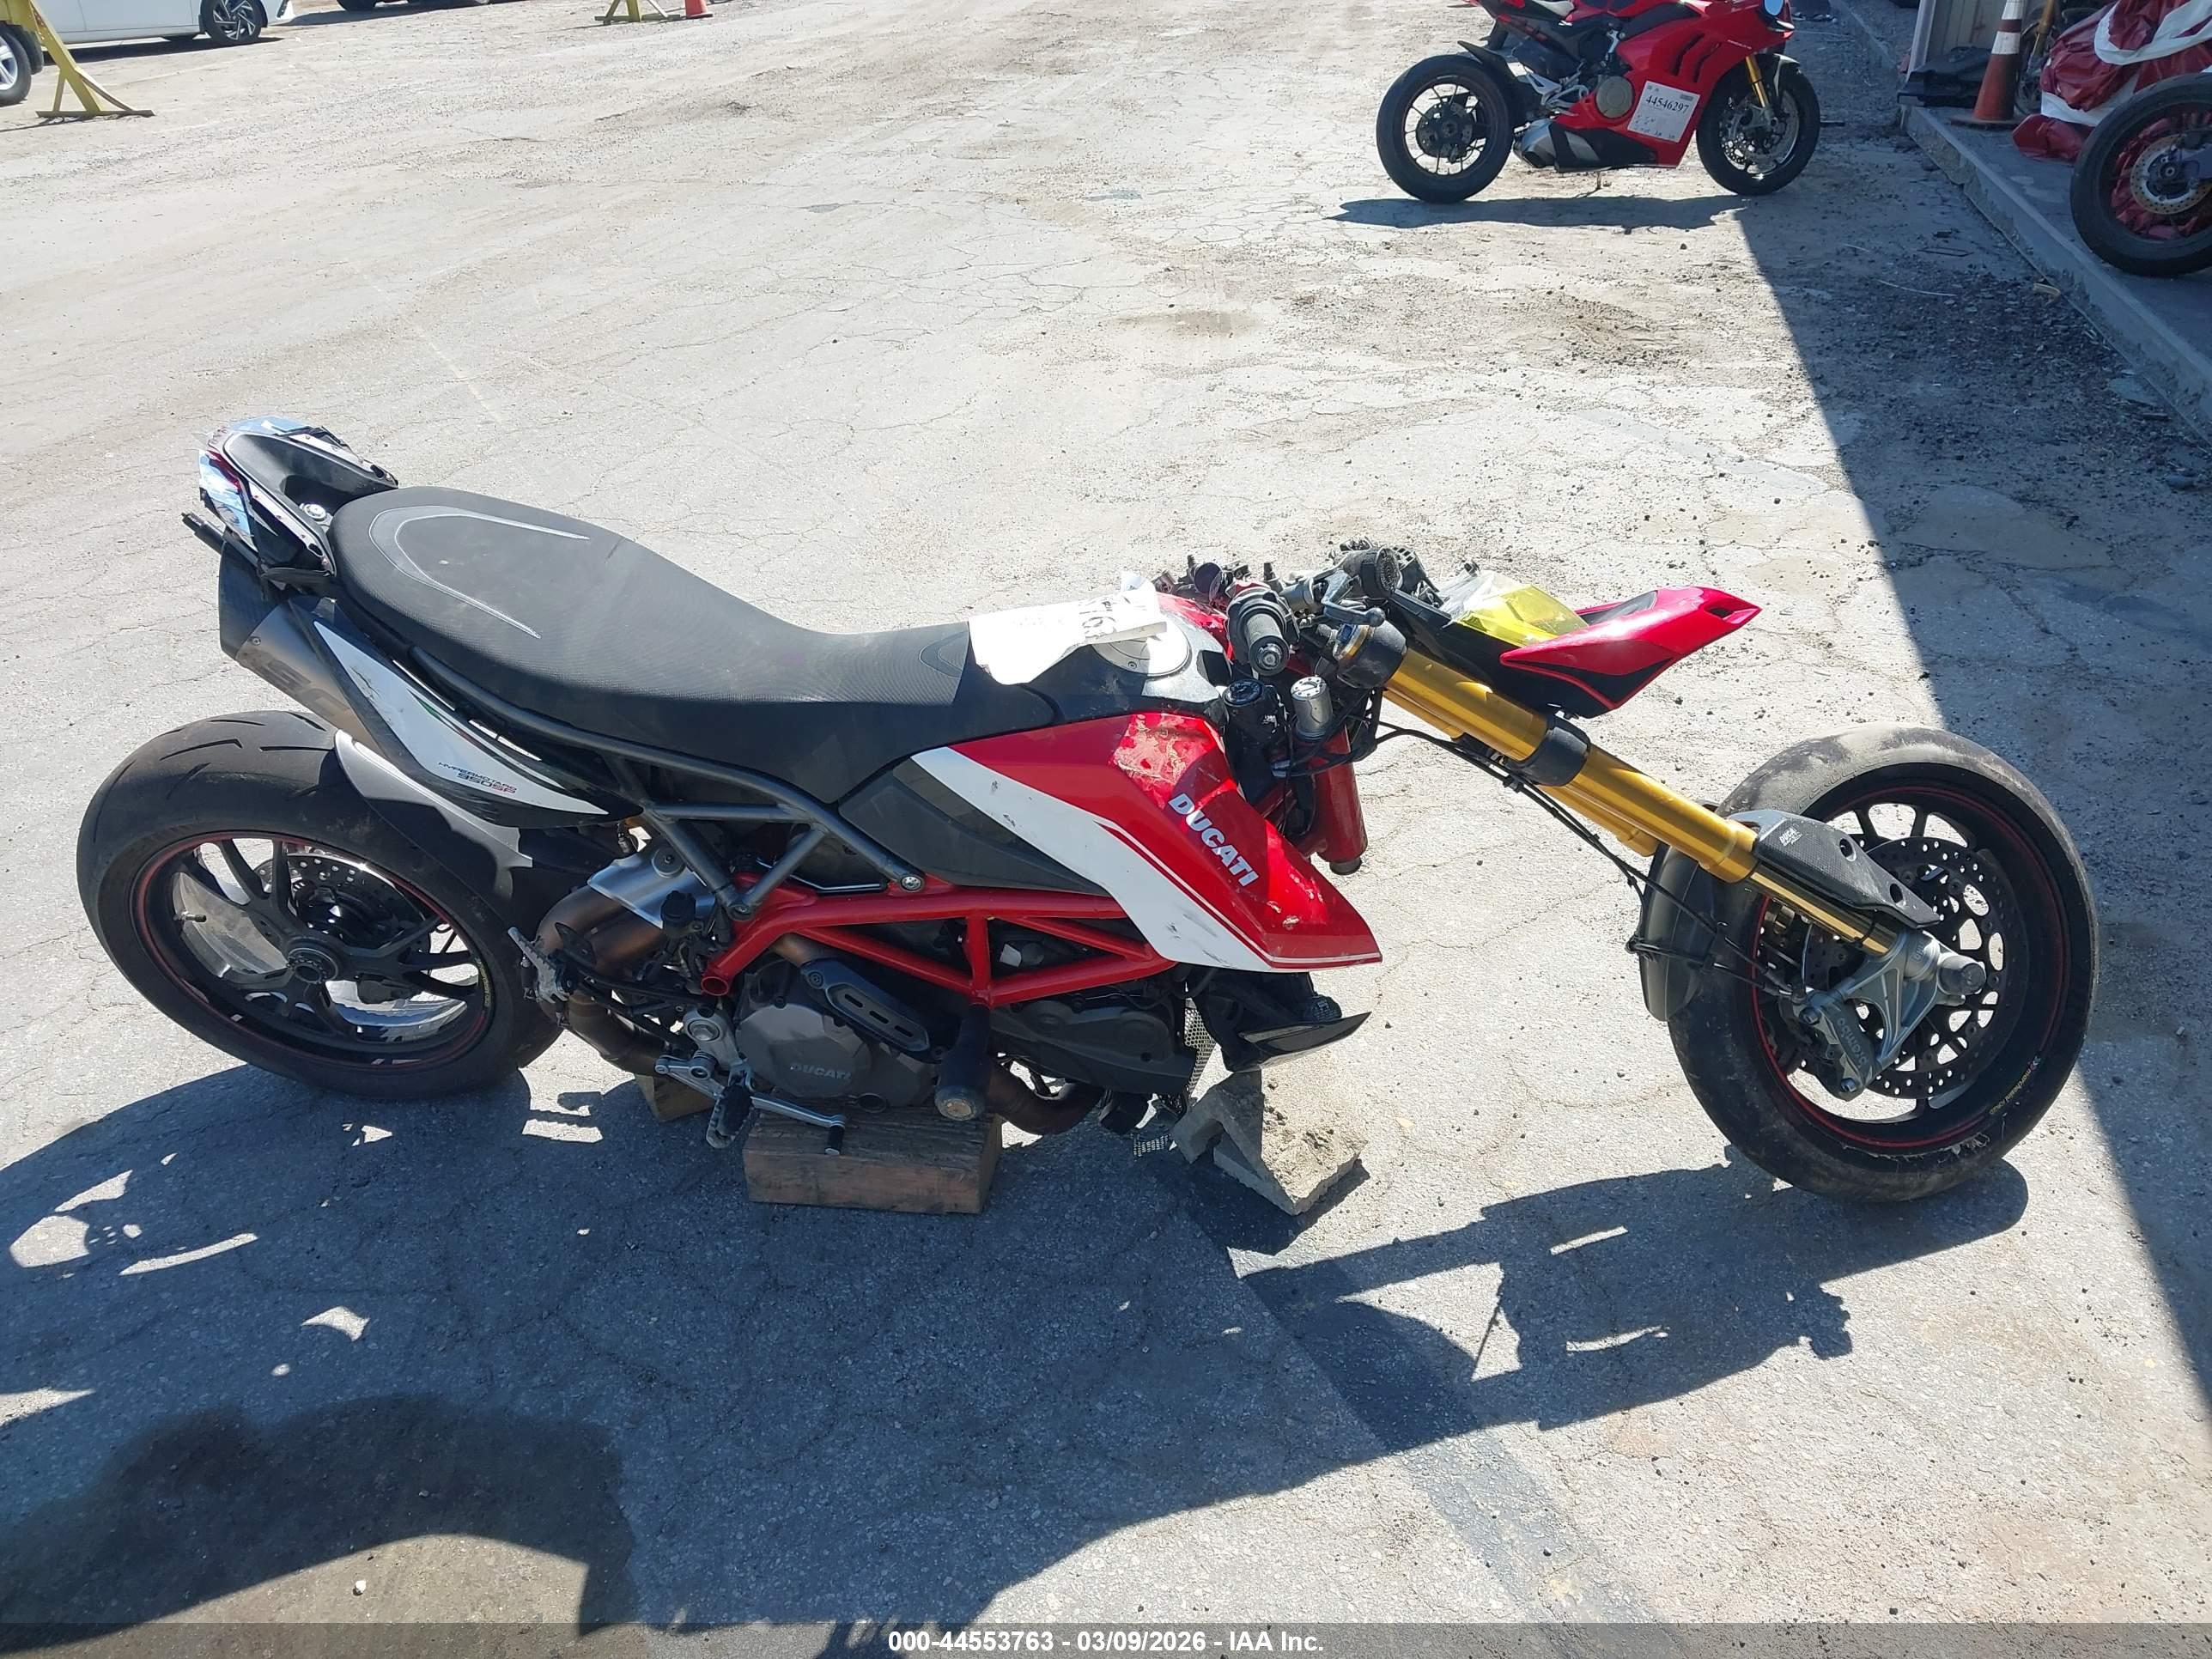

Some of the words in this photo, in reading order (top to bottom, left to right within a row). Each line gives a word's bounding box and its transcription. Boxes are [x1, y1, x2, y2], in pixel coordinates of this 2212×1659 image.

[1646, 95, 1689, 113] 44546297
[1168, 793, 1259, 887] DUCATI
[1838, 1018, 1869, 1069] brembo
[790, 1063, 852, 1080] DUCATI
